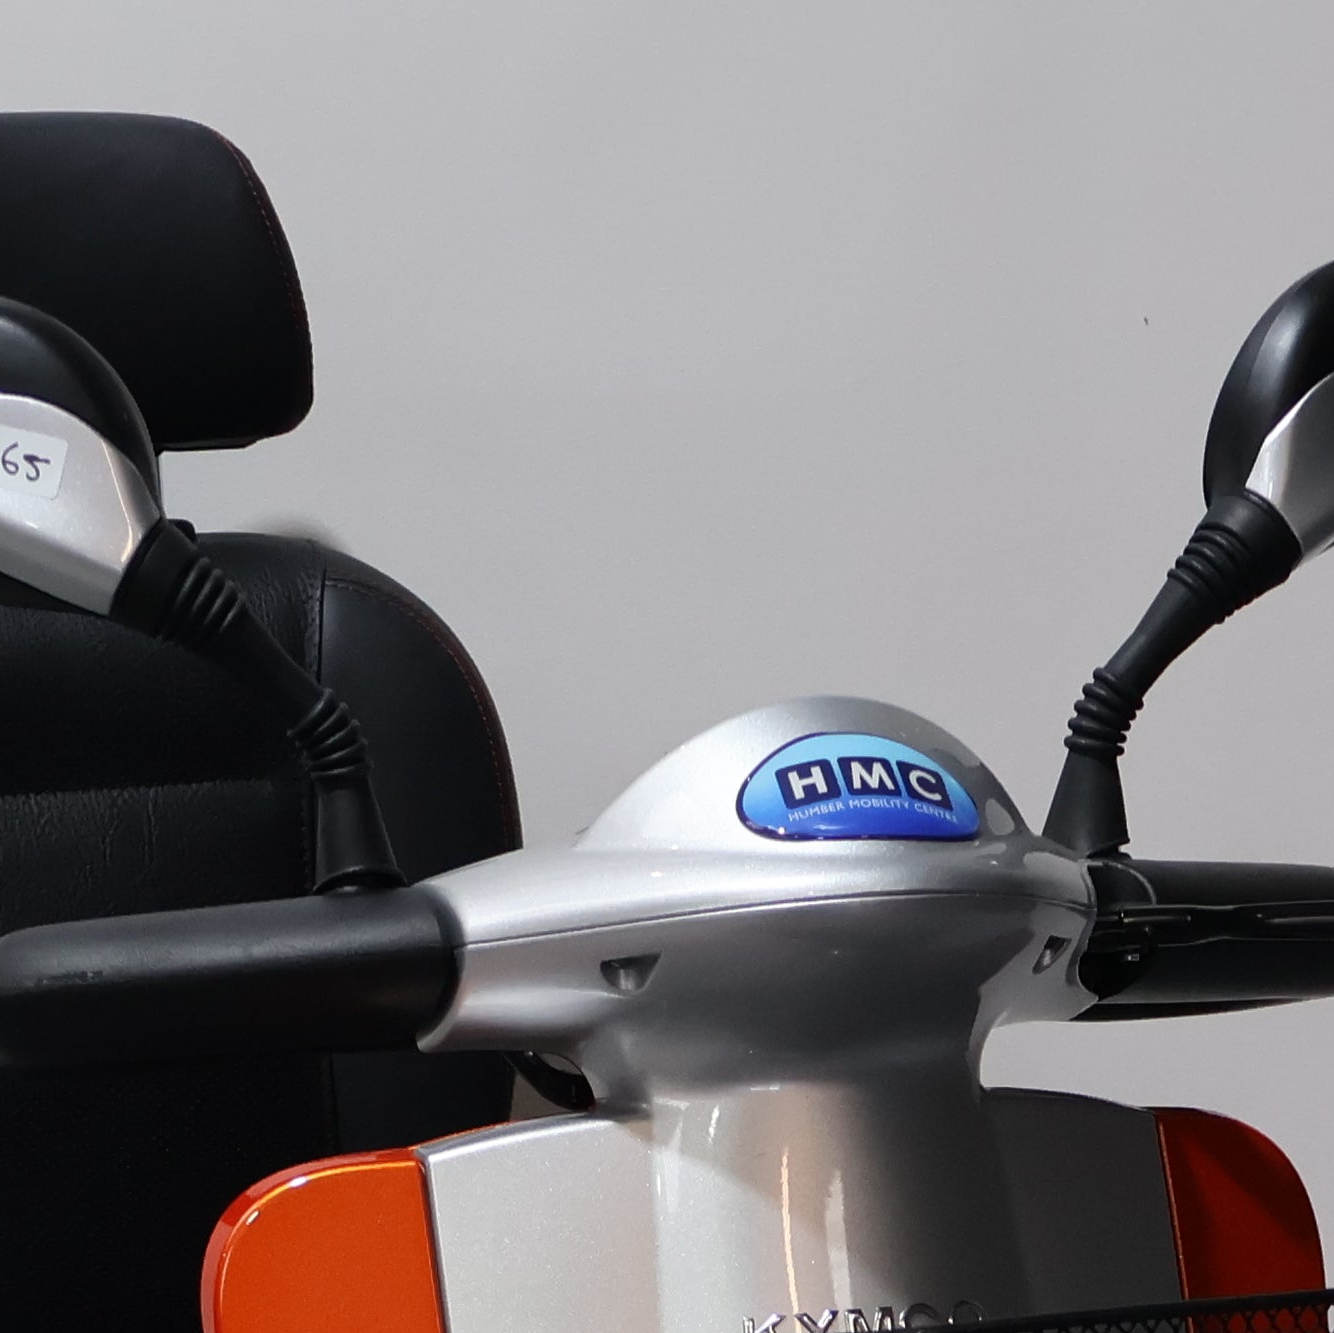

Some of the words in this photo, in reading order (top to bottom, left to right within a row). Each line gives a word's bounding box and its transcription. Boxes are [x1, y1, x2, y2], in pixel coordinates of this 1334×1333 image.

[787, 760, 944, 802] HMC
[787, 801, 845, 822] HUMBER
[849, 798, 910, 810] MOBILITY
